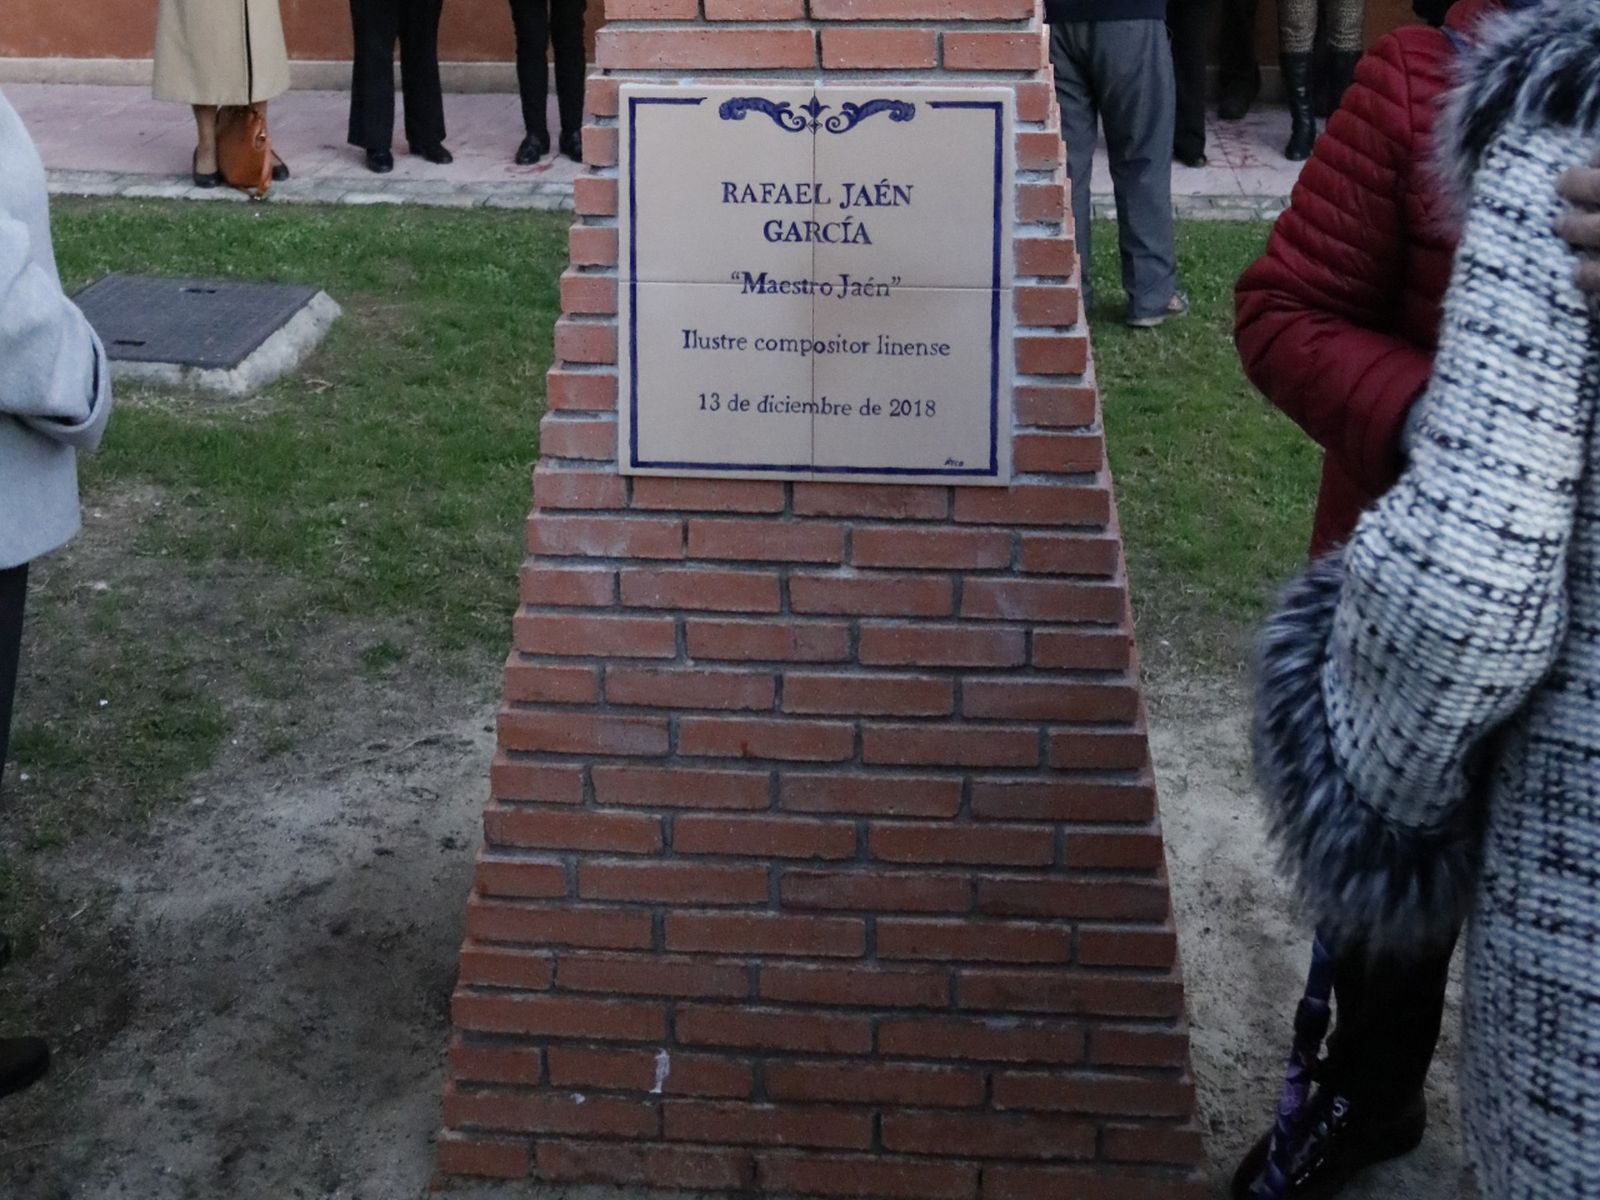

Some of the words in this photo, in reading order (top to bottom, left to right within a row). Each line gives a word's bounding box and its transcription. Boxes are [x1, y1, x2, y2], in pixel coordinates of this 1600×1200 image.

[721, 181, 831, 205] RAFAEL
[839, 178, 914, 209] JAÉN
[763, 216, 872, 245] GARCÍA
[681, 329, 747, 351] Ilustre
[754, 334, 870, 356] compositor
[876, 335, 951, 357] linense
[698, 392, 721, 412] 13
[727, 392, 750, 412] de
[757, 394, 852, 417] diciembre
[859, 397, 882, 417] de
[889, 398, 936, 418] 2018
